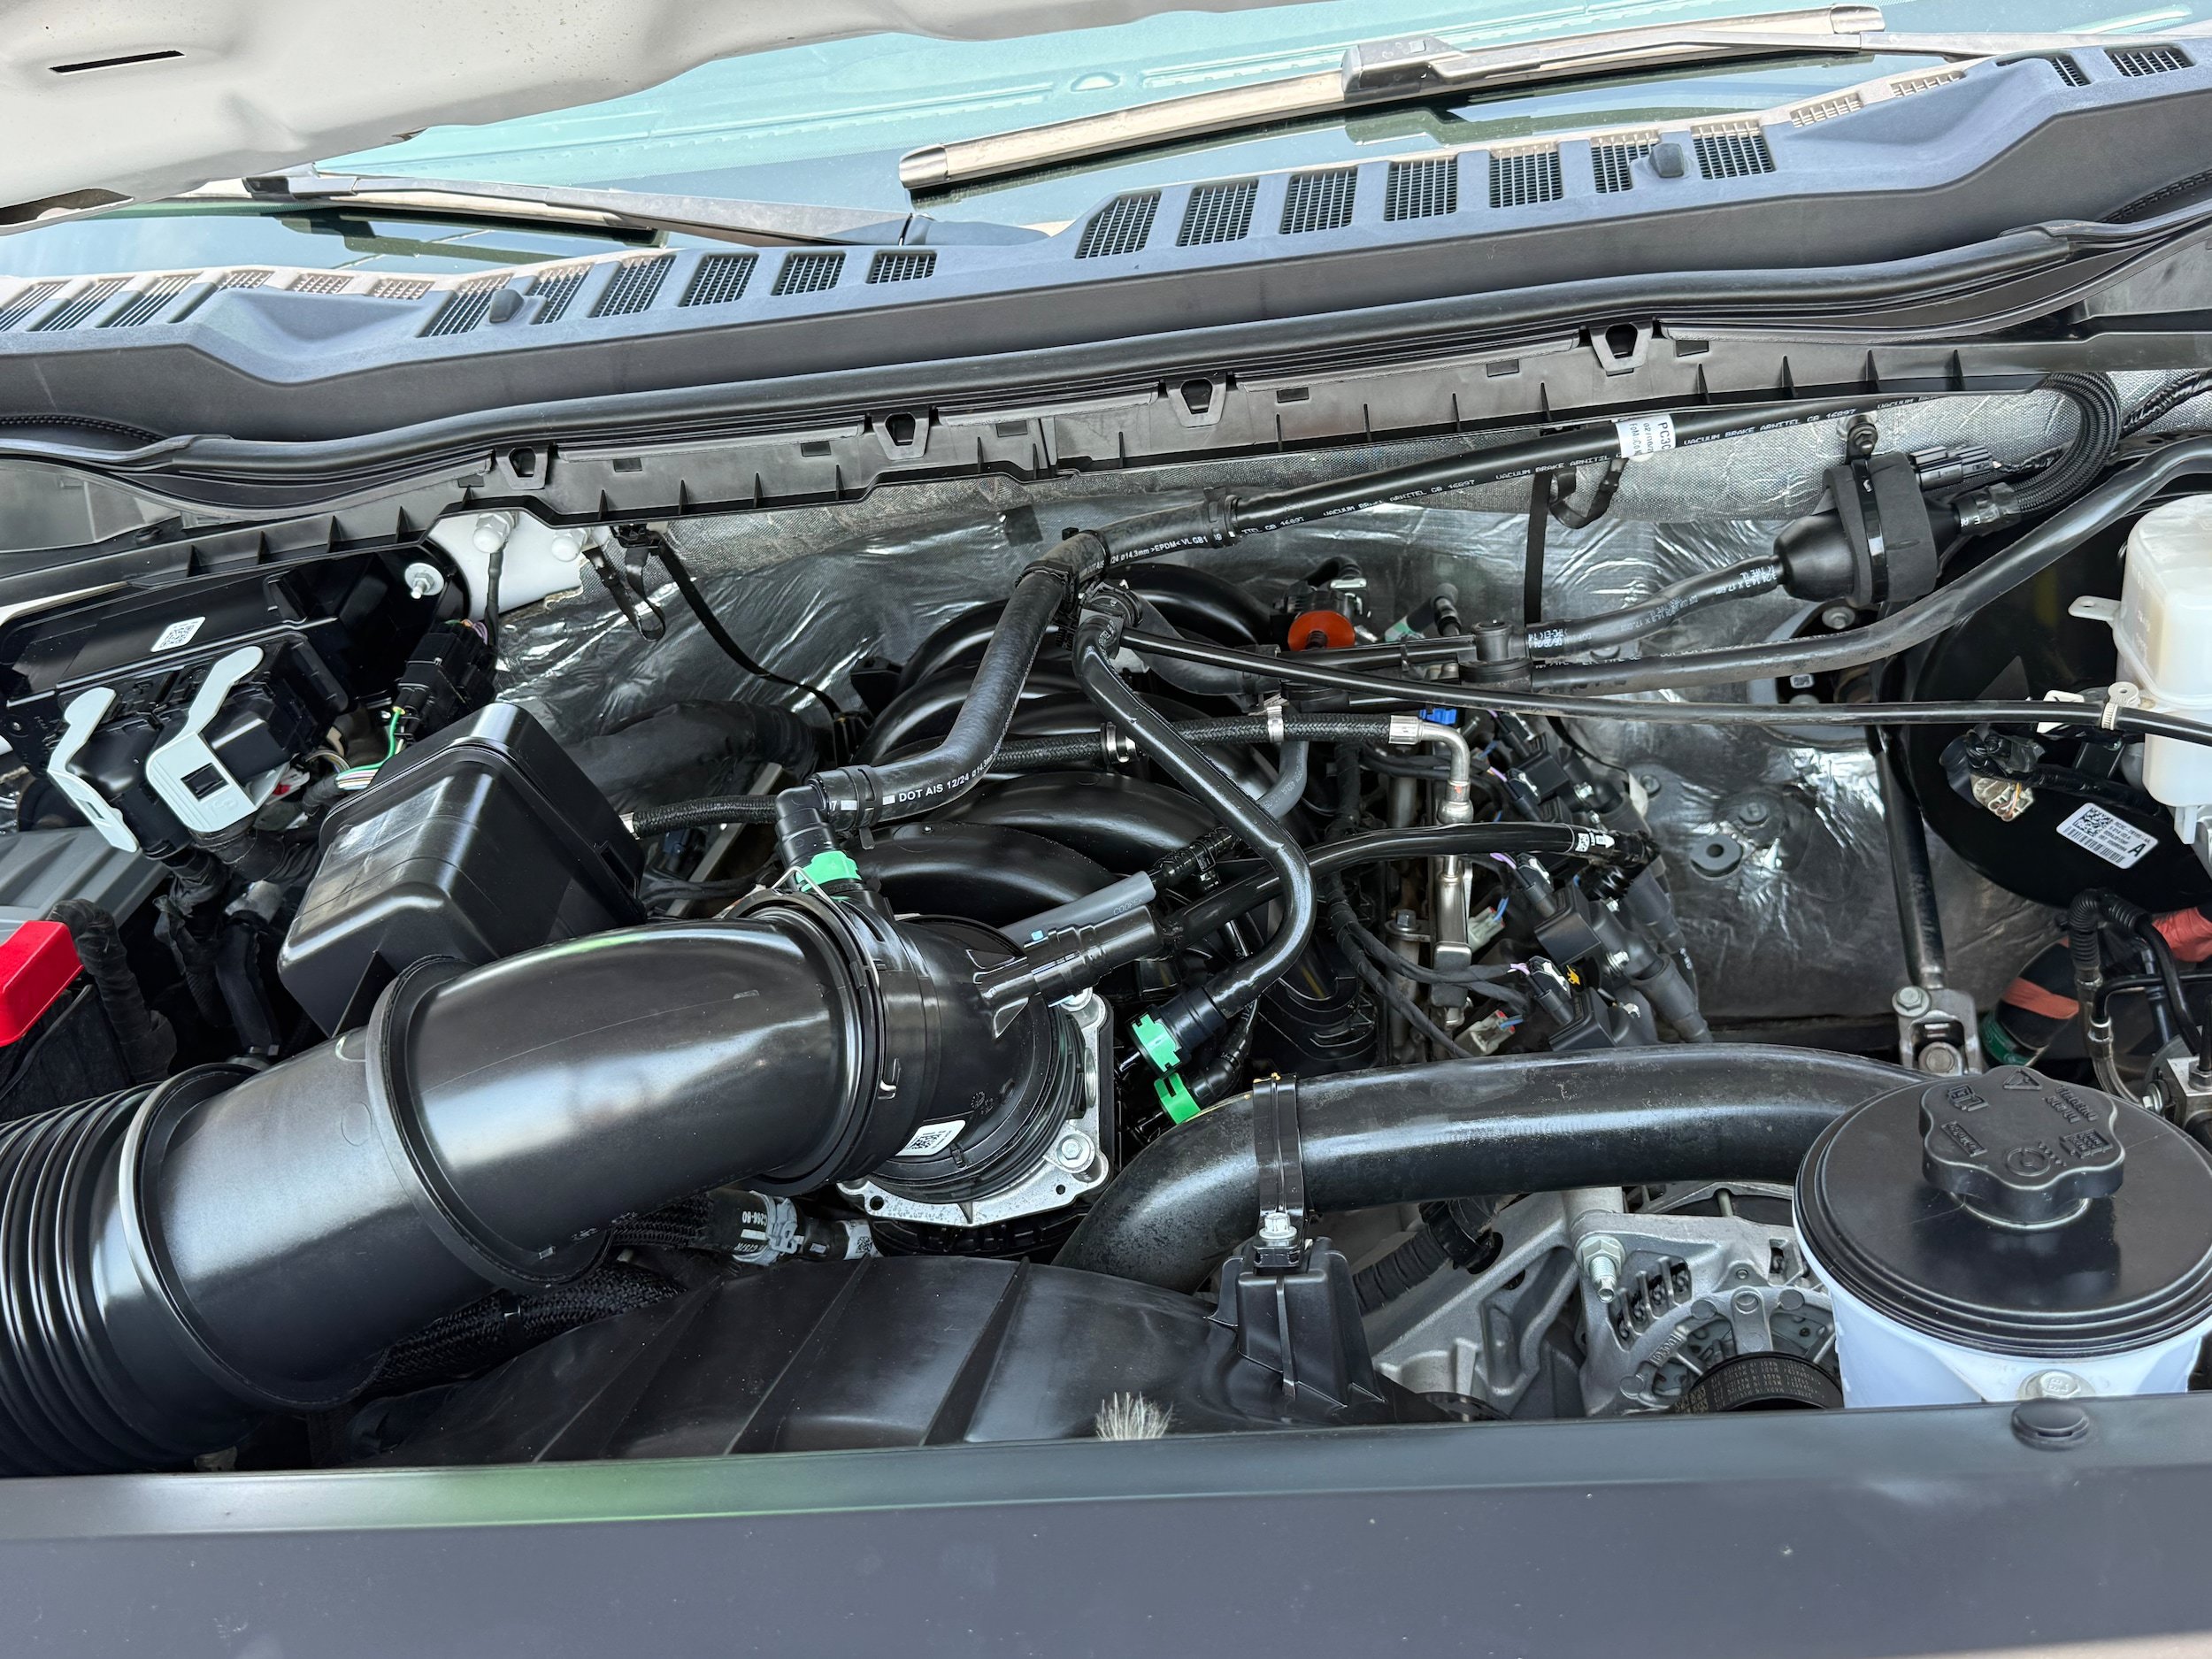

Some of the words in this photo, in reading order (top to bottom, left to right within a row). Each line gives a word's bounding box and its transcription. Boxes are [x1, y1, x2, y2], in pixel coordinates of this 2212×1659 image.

[1683, 433, 1721, 446] VACUUM
[1724, 426, 1755, 438] BRAKE
[1759, 418, 1801, 430] ARNITEL
[1495, 469, 1532, 480] VACUUM
[1535, 462, 1565, 473] BRAKE
[1569, 455, 1610, 466] ARNITEL
[1180, 537, 1192, 546] VL
[899, 788, 922, 803] DOT
[926, 784, 944, 796] AIS
[947, 772, 970, 790] 12/24
[2127, 843, 2147, 857] A
